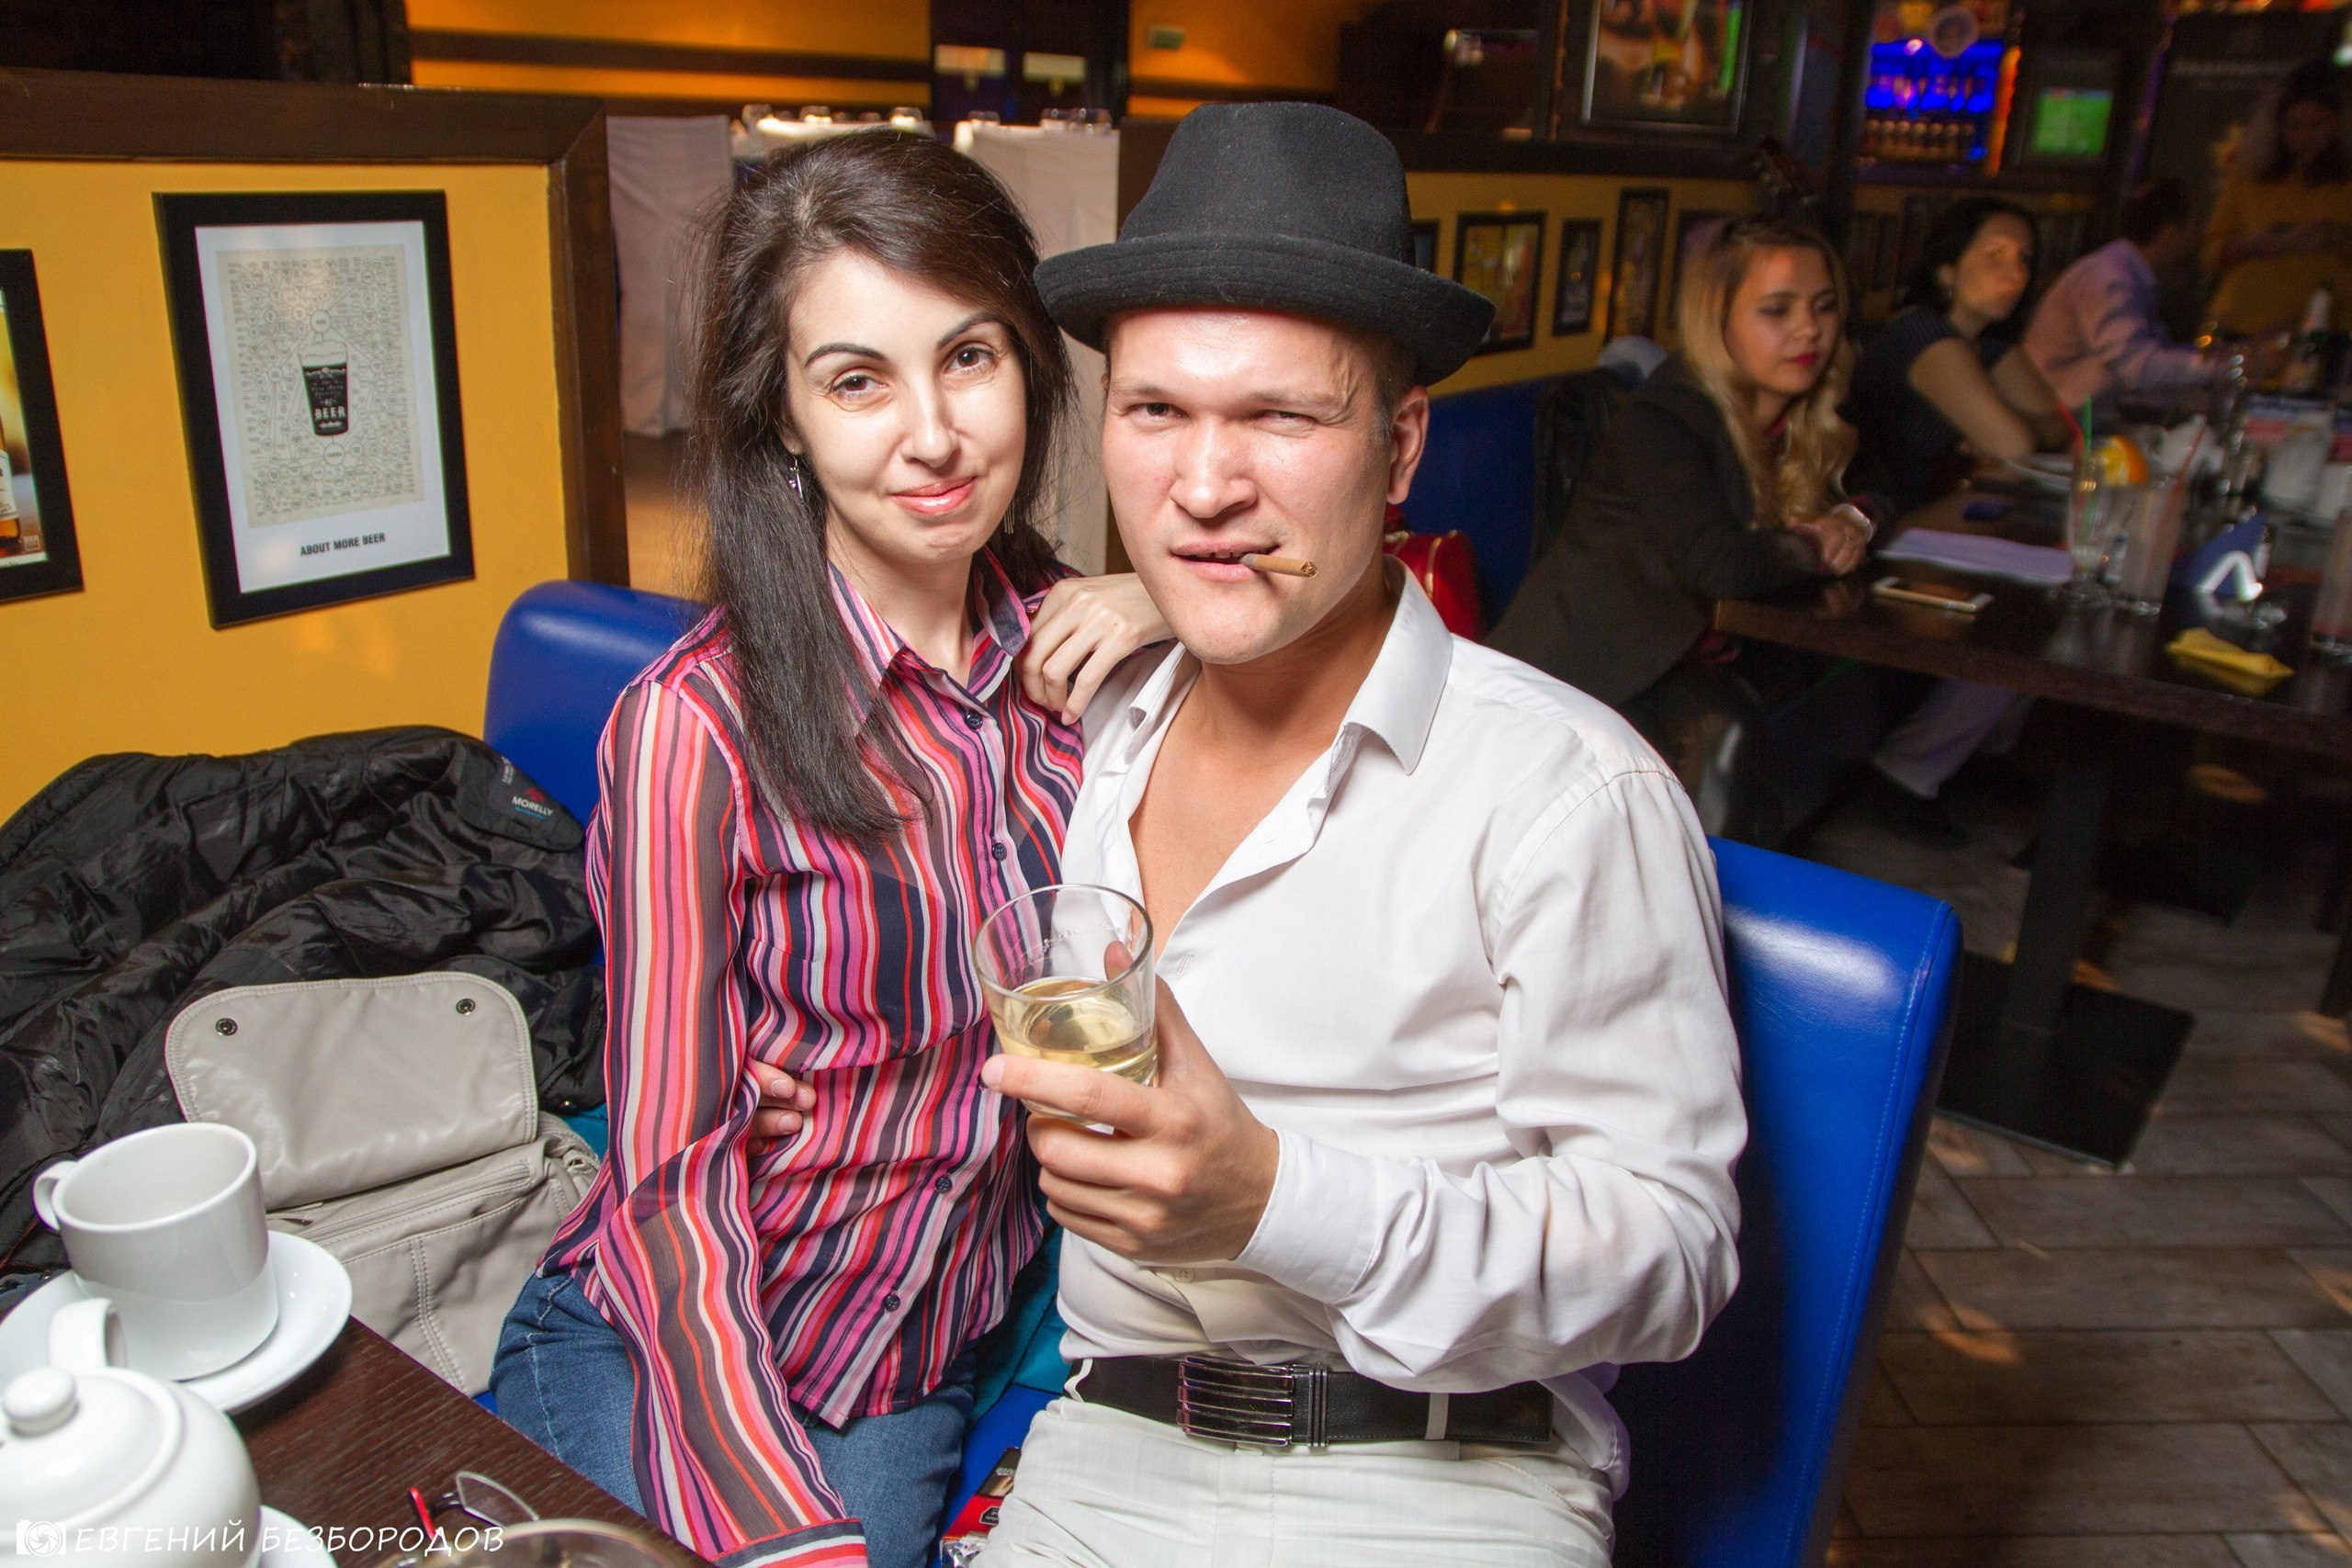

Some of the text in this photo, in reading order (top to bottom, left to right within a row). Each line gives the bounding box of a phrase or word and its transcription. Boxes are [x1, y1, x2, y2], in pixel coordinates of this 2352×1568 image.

[314, 406, 346, 421] BEER
[300, 532, 385, 556] ABOUT MORE BEER
[512, 795, 553, 816] MORELLY
